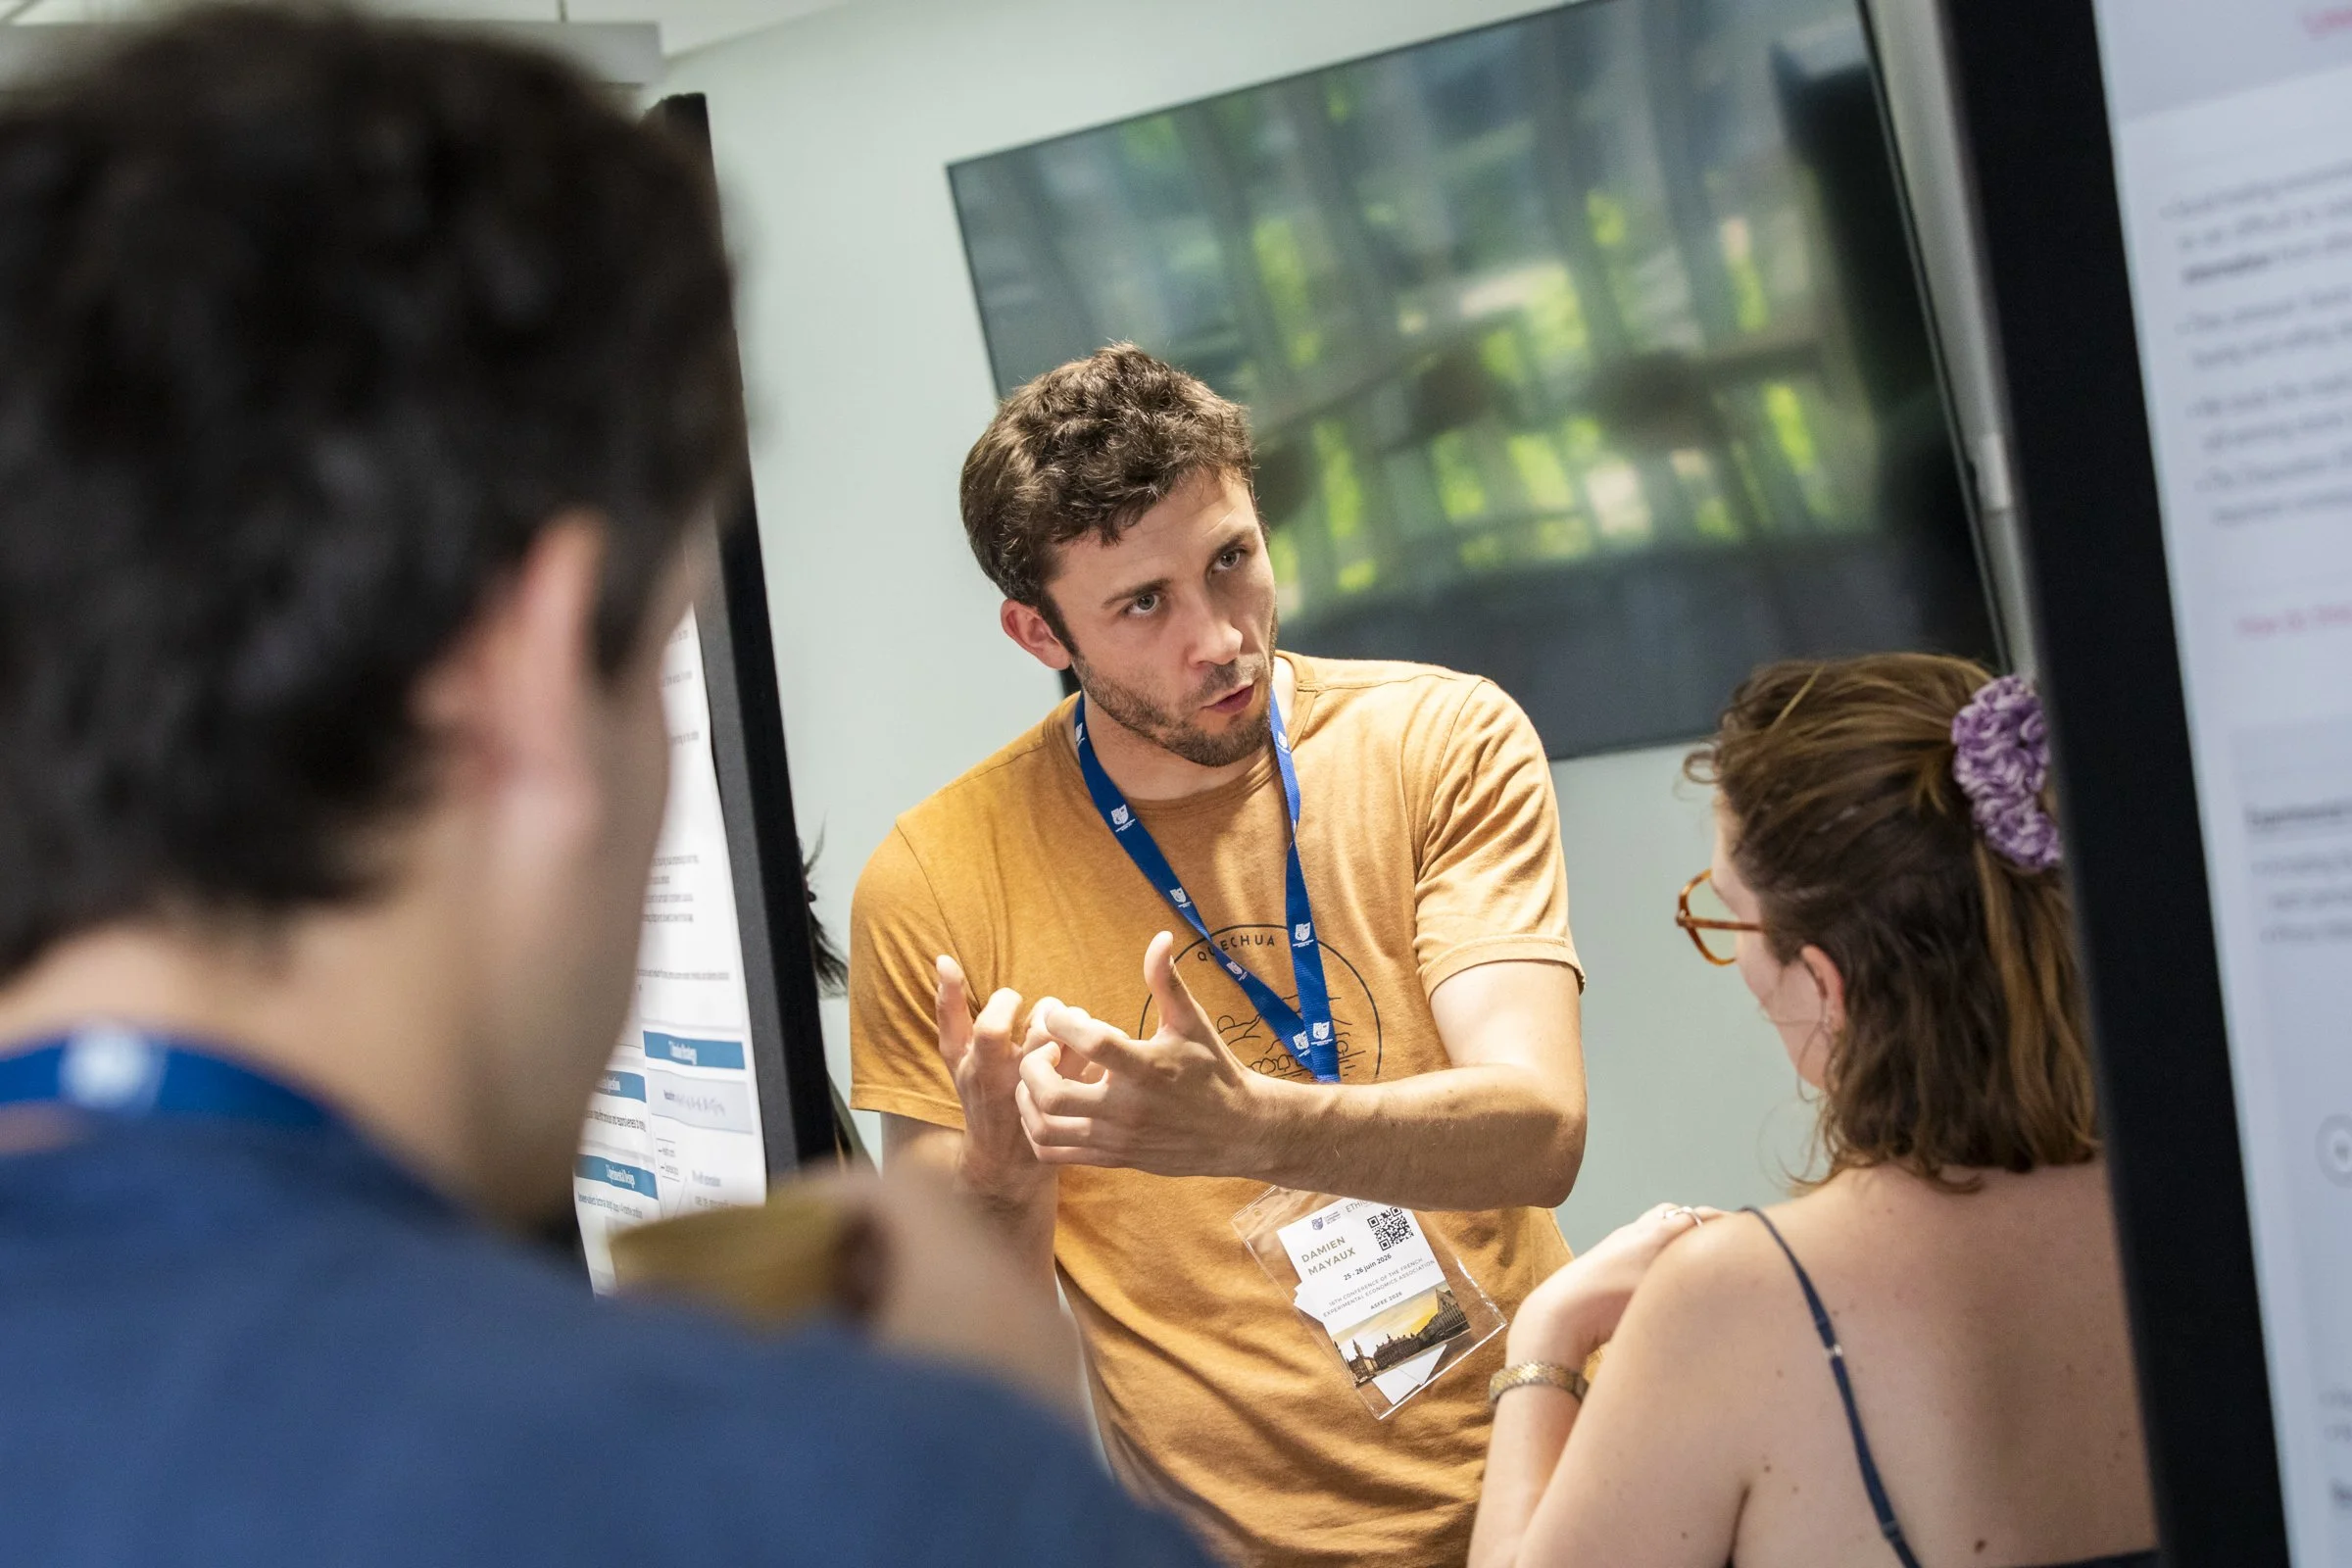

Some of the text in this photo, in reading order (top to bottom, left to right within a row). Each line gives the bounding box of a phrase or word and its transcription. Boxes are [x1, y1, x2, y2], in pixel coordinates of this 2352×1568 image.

[1198, 934, 1275, 961] QUECHUA
[1301, 1236, 1346, 1263] DAMIEN
[1307, 1247, 1356, 1275] MAYAUX
[1363, 1261, 1377, 1273] juin
[1377, 1253, 1393, 1264] 2026
[1323, 1260, 1435, 1317] EXPERIMENTAL ECONOMICS ASSOCIATION
[1343, 1279, 1379, 1300] CONFERENCE
[1400, 1257, 1423, 1271] FRENCH
[1370, 1298, 1388, 1309] ASFEE
